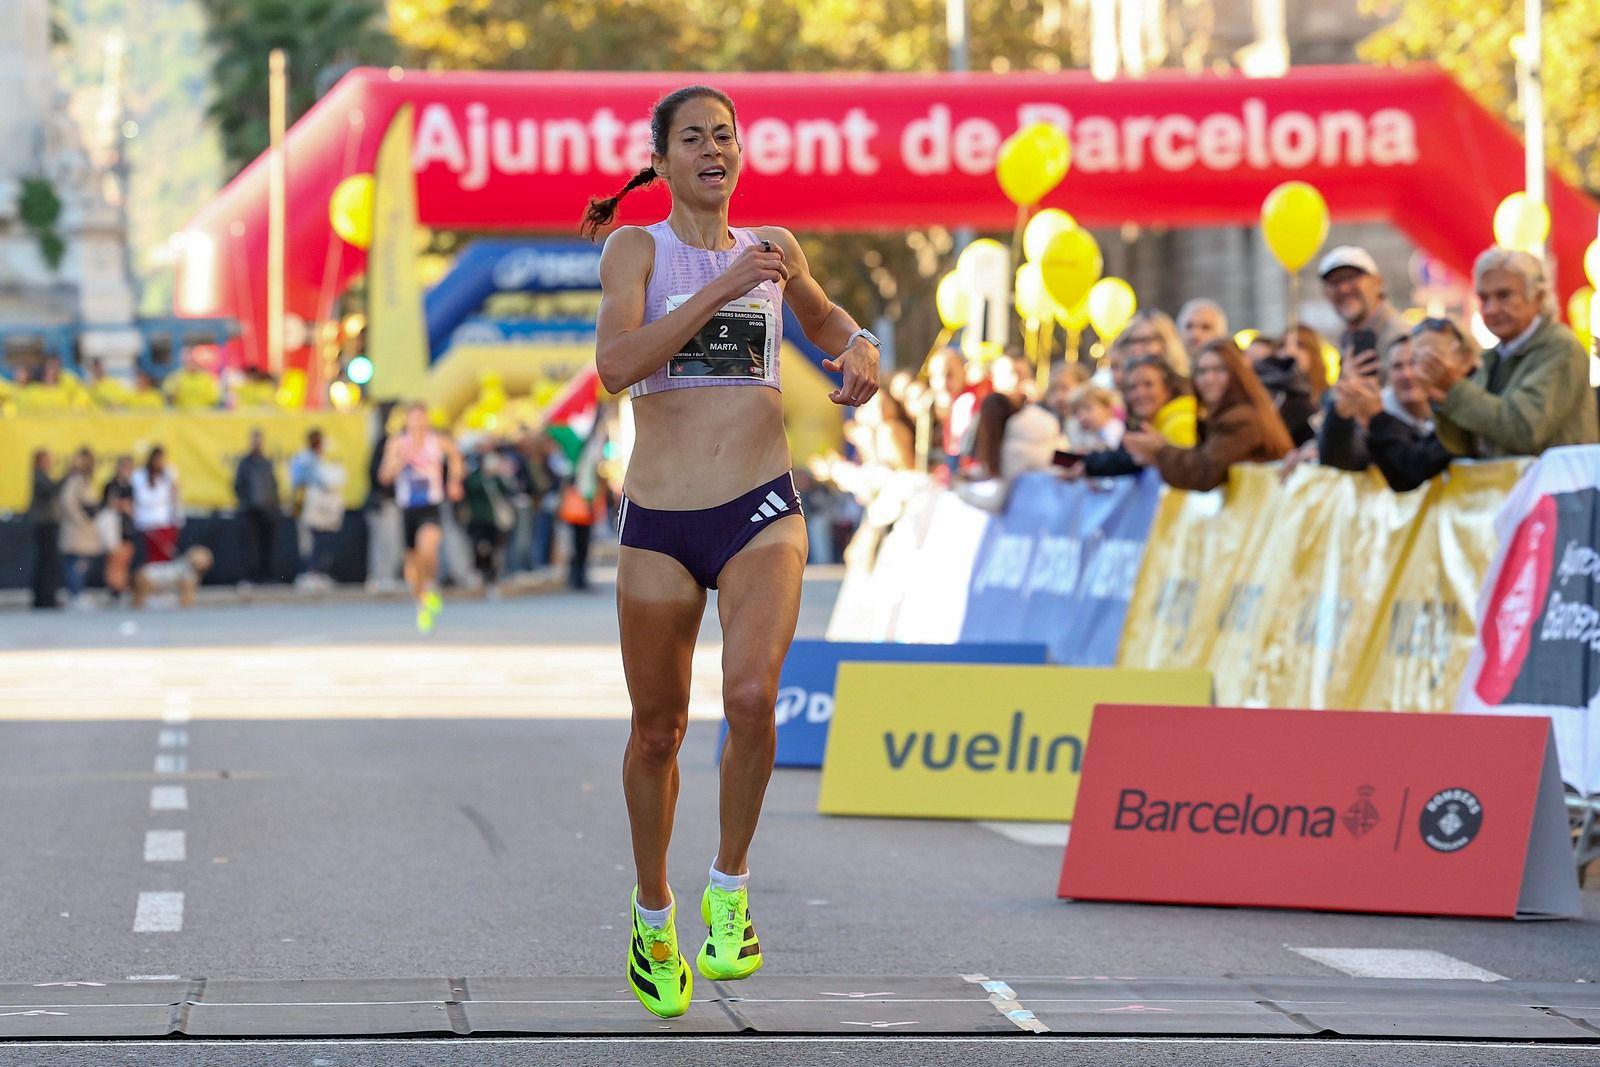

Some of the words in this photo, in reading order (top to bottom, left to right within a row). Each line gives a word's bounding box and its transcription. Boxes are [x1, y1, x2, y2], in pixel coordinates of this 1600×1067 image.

[412, 102, 878, 190] Ajuntaent
[902, 102, 1000, 174] de
[709, 343, 738, 351] MARTA
[719, 325, 729, 338] 2
[883, 710, 1083, 774] vuelin
[1113, 788, 1336, 838] Barcelona
[1426, 788, 1481, 815] BOMBERS
